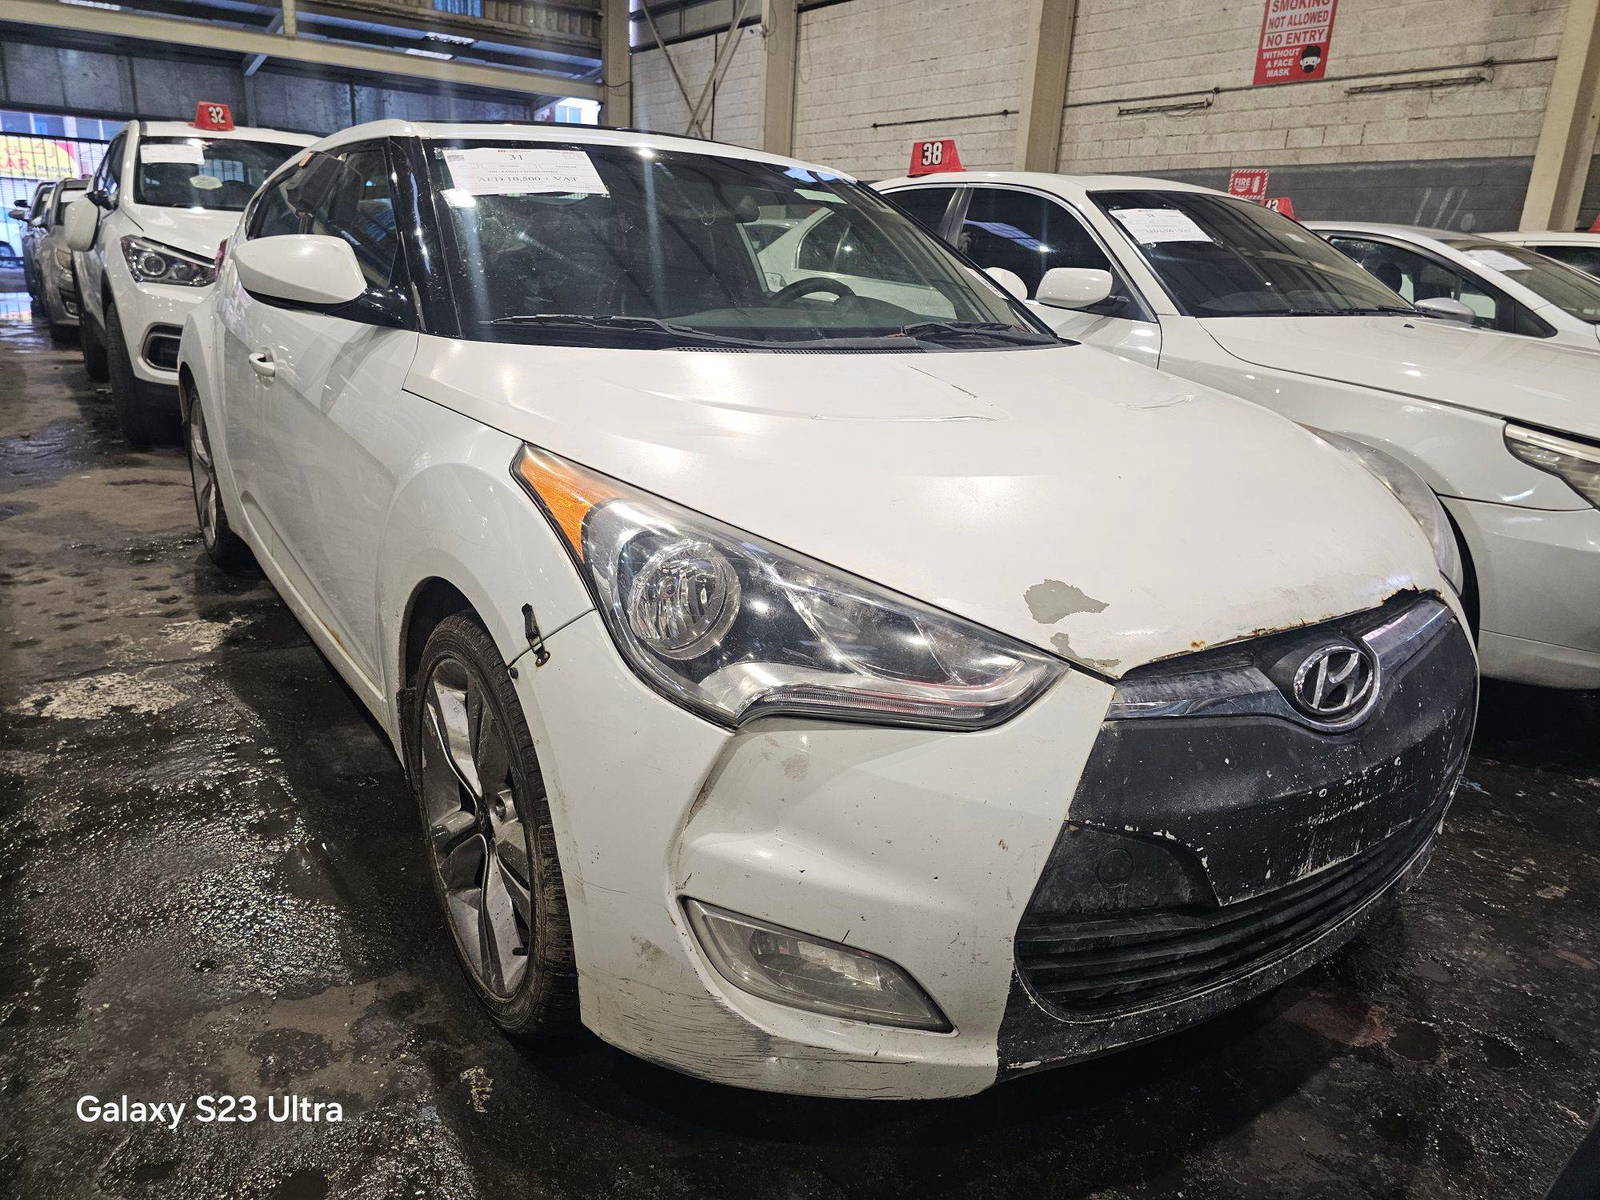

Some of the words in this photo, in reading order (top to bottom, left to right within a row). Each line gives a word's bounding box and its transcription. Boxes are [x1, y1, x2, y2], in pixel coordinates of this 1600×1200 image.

[1267, 16, 1286, 29] NOT
[1287, 10, 1329, 26] ALLOWED
[1266, 34, 1283, 47] NO
[1286, 29, 1325, 44] ENTRY
[1262, 48, 1300, 59] WITHOUT
[1265, 60, 1272, 68] A
[1272, 58, 1294, 68] FACE
[1266, 68, 1290, 77] MASK
[208, 106, 225, 124] 32
[922, 141, 943, 166] 38
[0, 158, 30, 171] AR
[1234, 177, 1251, 186] FIRE
